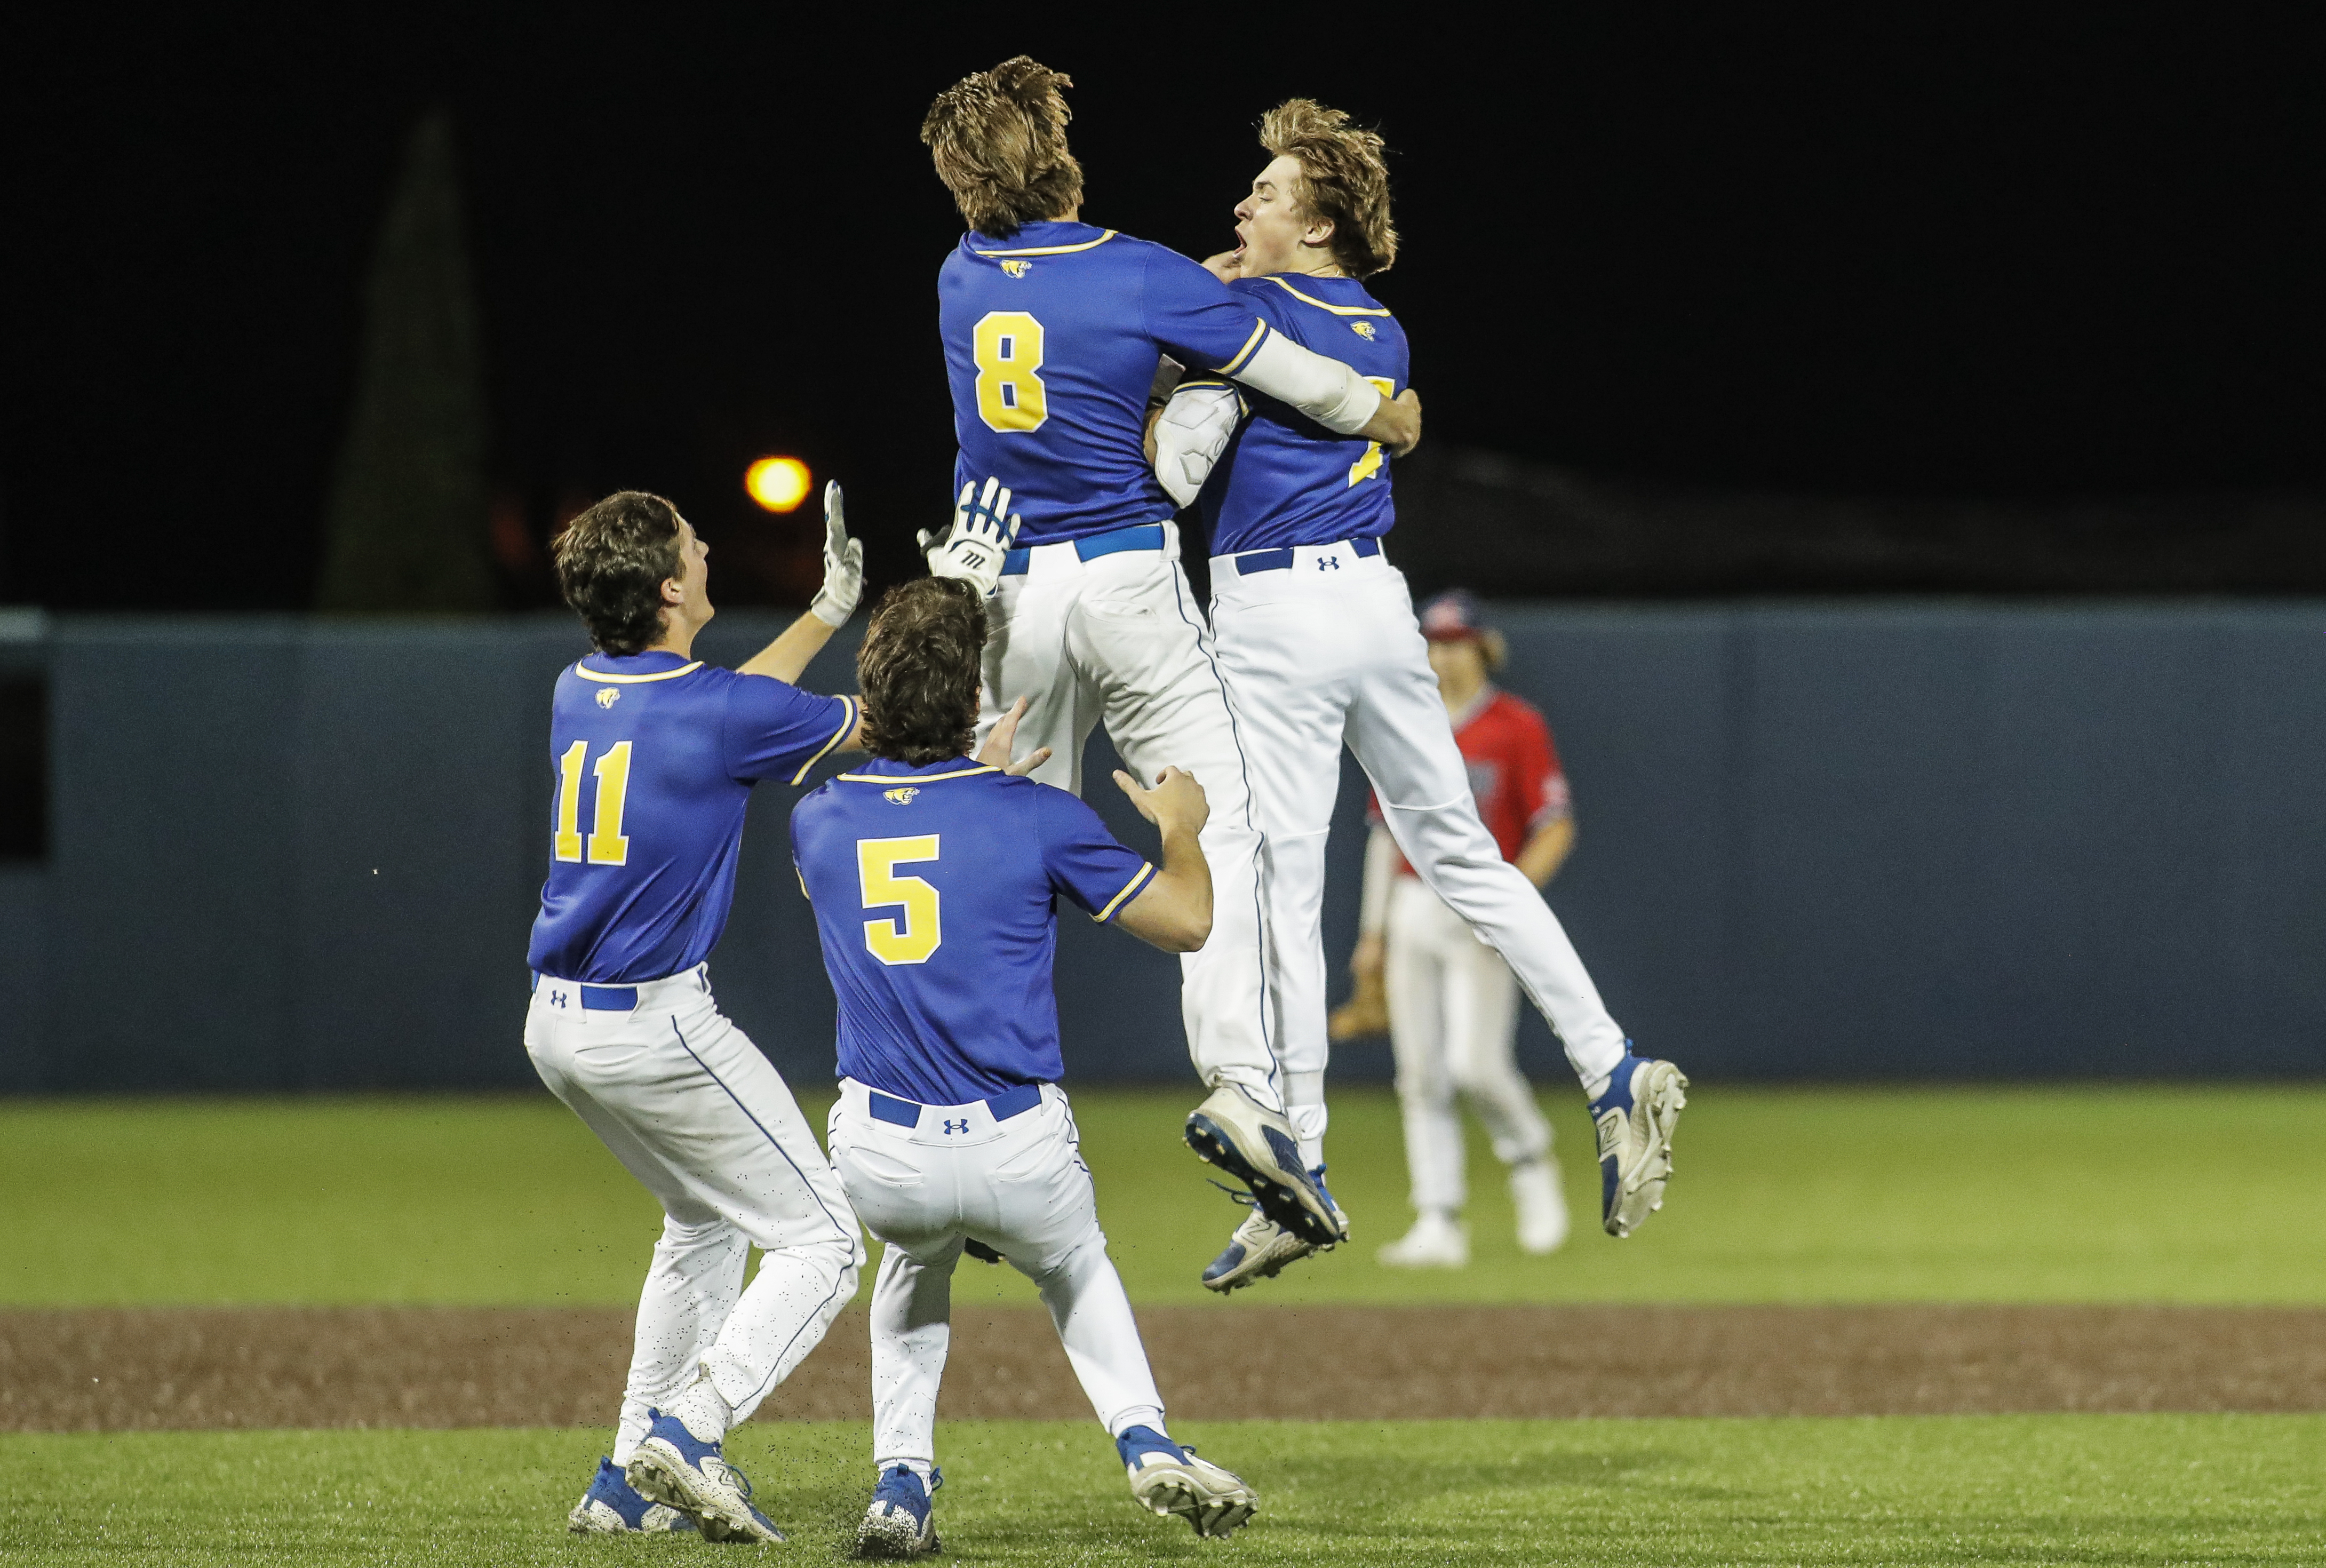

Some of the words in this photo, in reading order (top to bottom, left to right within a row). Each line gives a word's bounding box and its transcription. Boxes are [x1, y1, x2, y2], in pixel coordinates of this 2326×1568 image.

[973, 311, 1049, 433] 8
[554, 740, 633, 866] 11
[856, 834, 941, 966] 5
